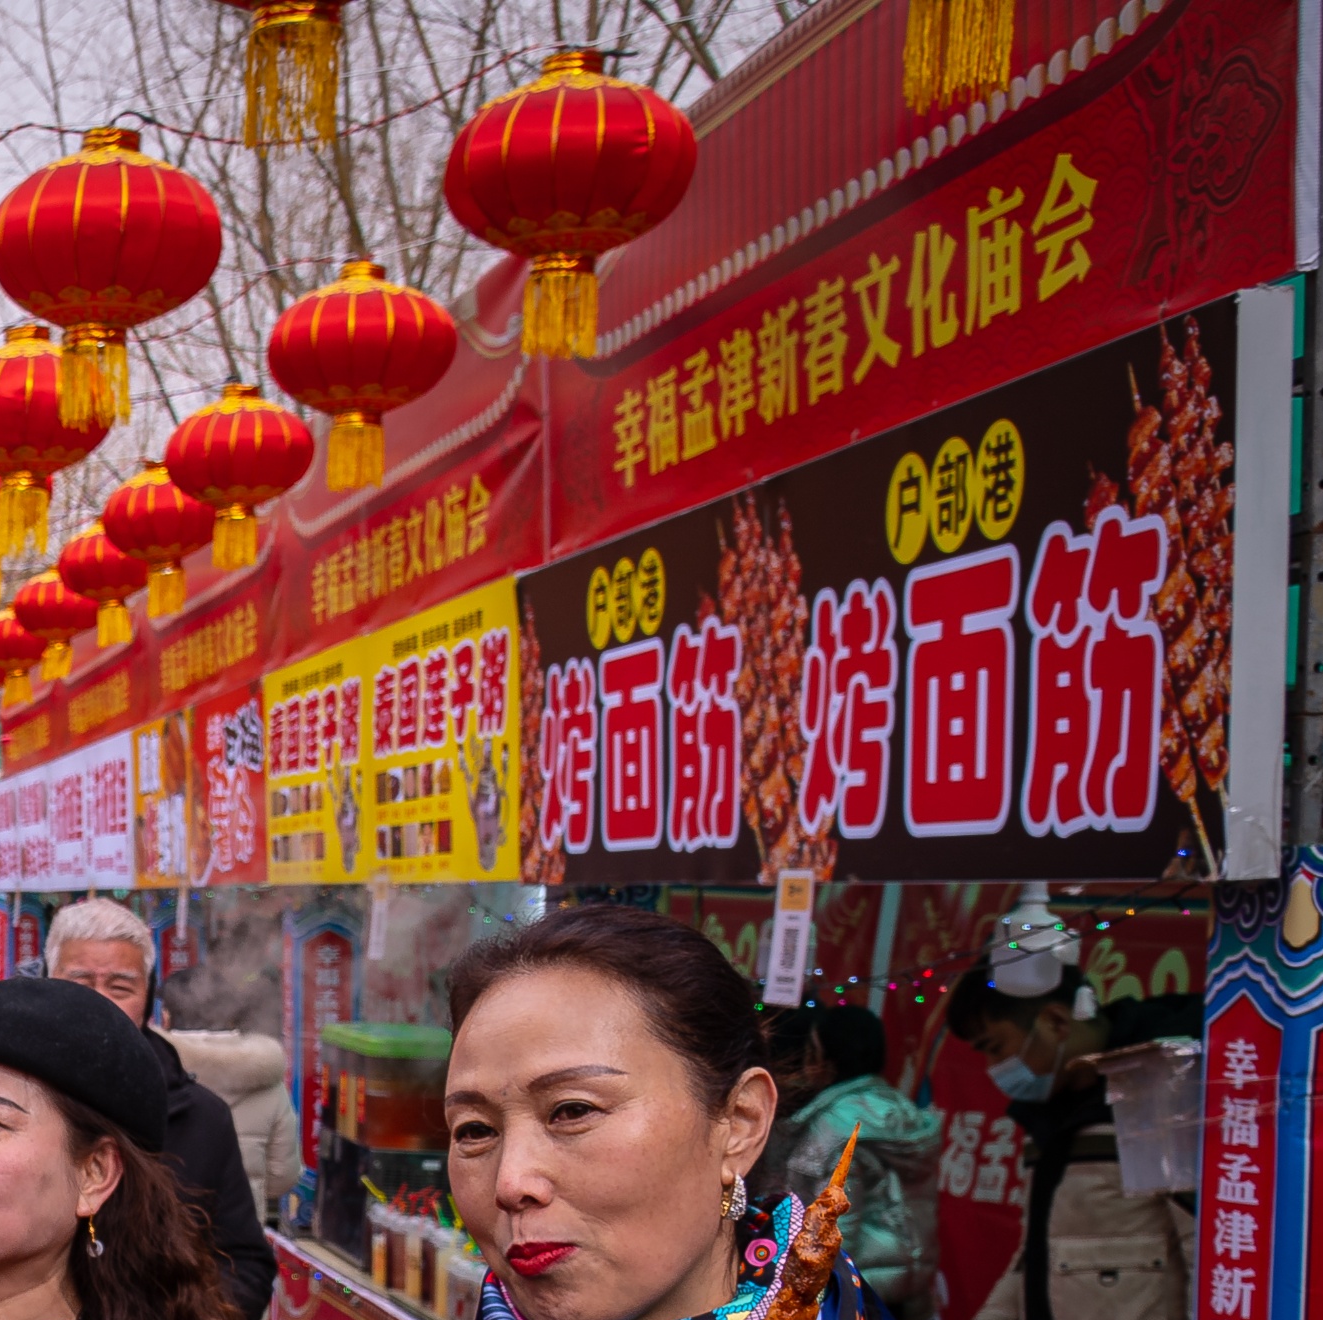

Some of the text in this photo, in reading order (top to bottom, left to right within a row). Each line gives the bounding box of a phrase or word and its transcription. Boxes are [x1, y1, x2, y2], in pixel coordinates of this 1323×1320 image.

[612, 153, 1098, 488] 幸福孟津新春文化庙会
[892, 428, 1017, 550] 户部港
[540, 616, 744, 854] 烤面筋
[799, 505, 1169, 840] 烤面筋
